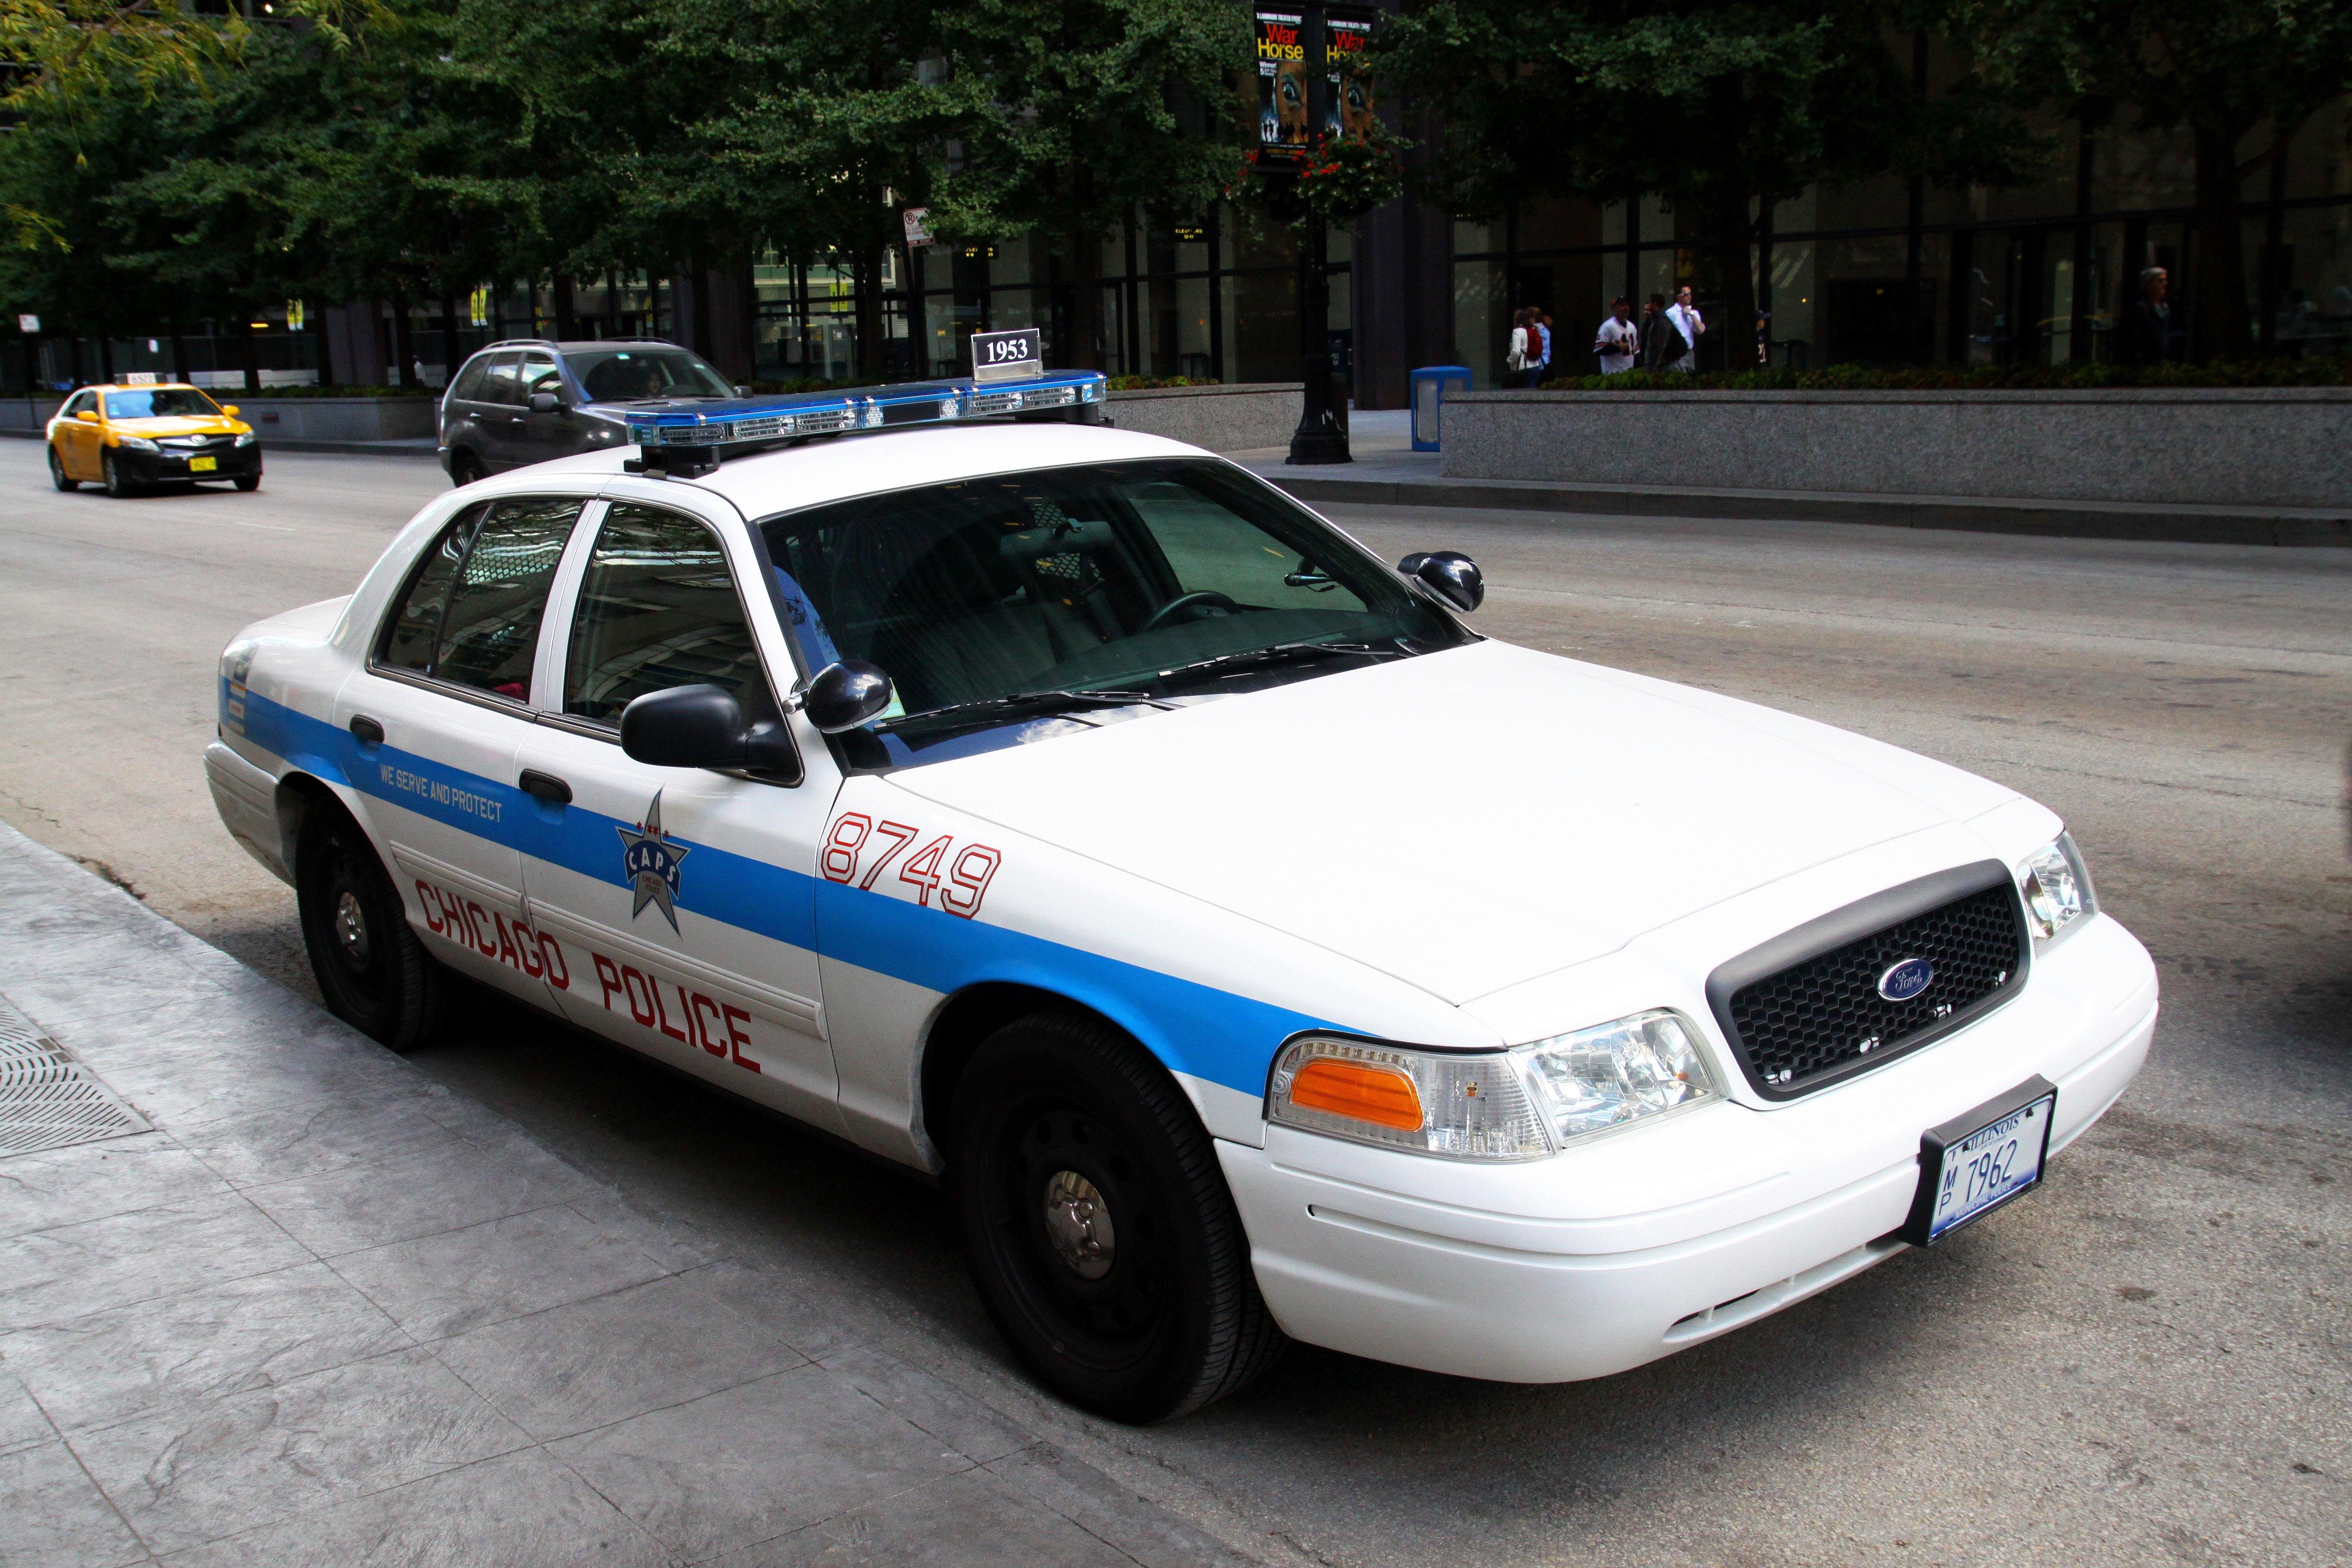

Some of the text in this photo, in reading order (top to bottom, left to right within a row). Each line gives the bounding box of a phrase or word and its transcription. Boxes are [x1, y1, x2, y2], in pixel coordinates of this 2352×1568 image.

[1258, 38, 1304, 60] Horse
[1266, 23, 1299, 44] War
[1335, 31, 1366, 52] War
[987, 339, 1028, 362] 1953
[380, 764, 502, 823] WE SERVE AND PROTECT
[629, 847, 676, 882] CAPS
[821, 811, 1001, 920] 8749
[415, 879, 762, 1074] CHICAGO POLICE
[1895, 967, 1922, 992] Ford
[1970, 1115, 2019, 1151] ILLINOIS
[1966, 1139, 2017, 1202] 7962
[1939, 1165, 1959, 1216] M P
